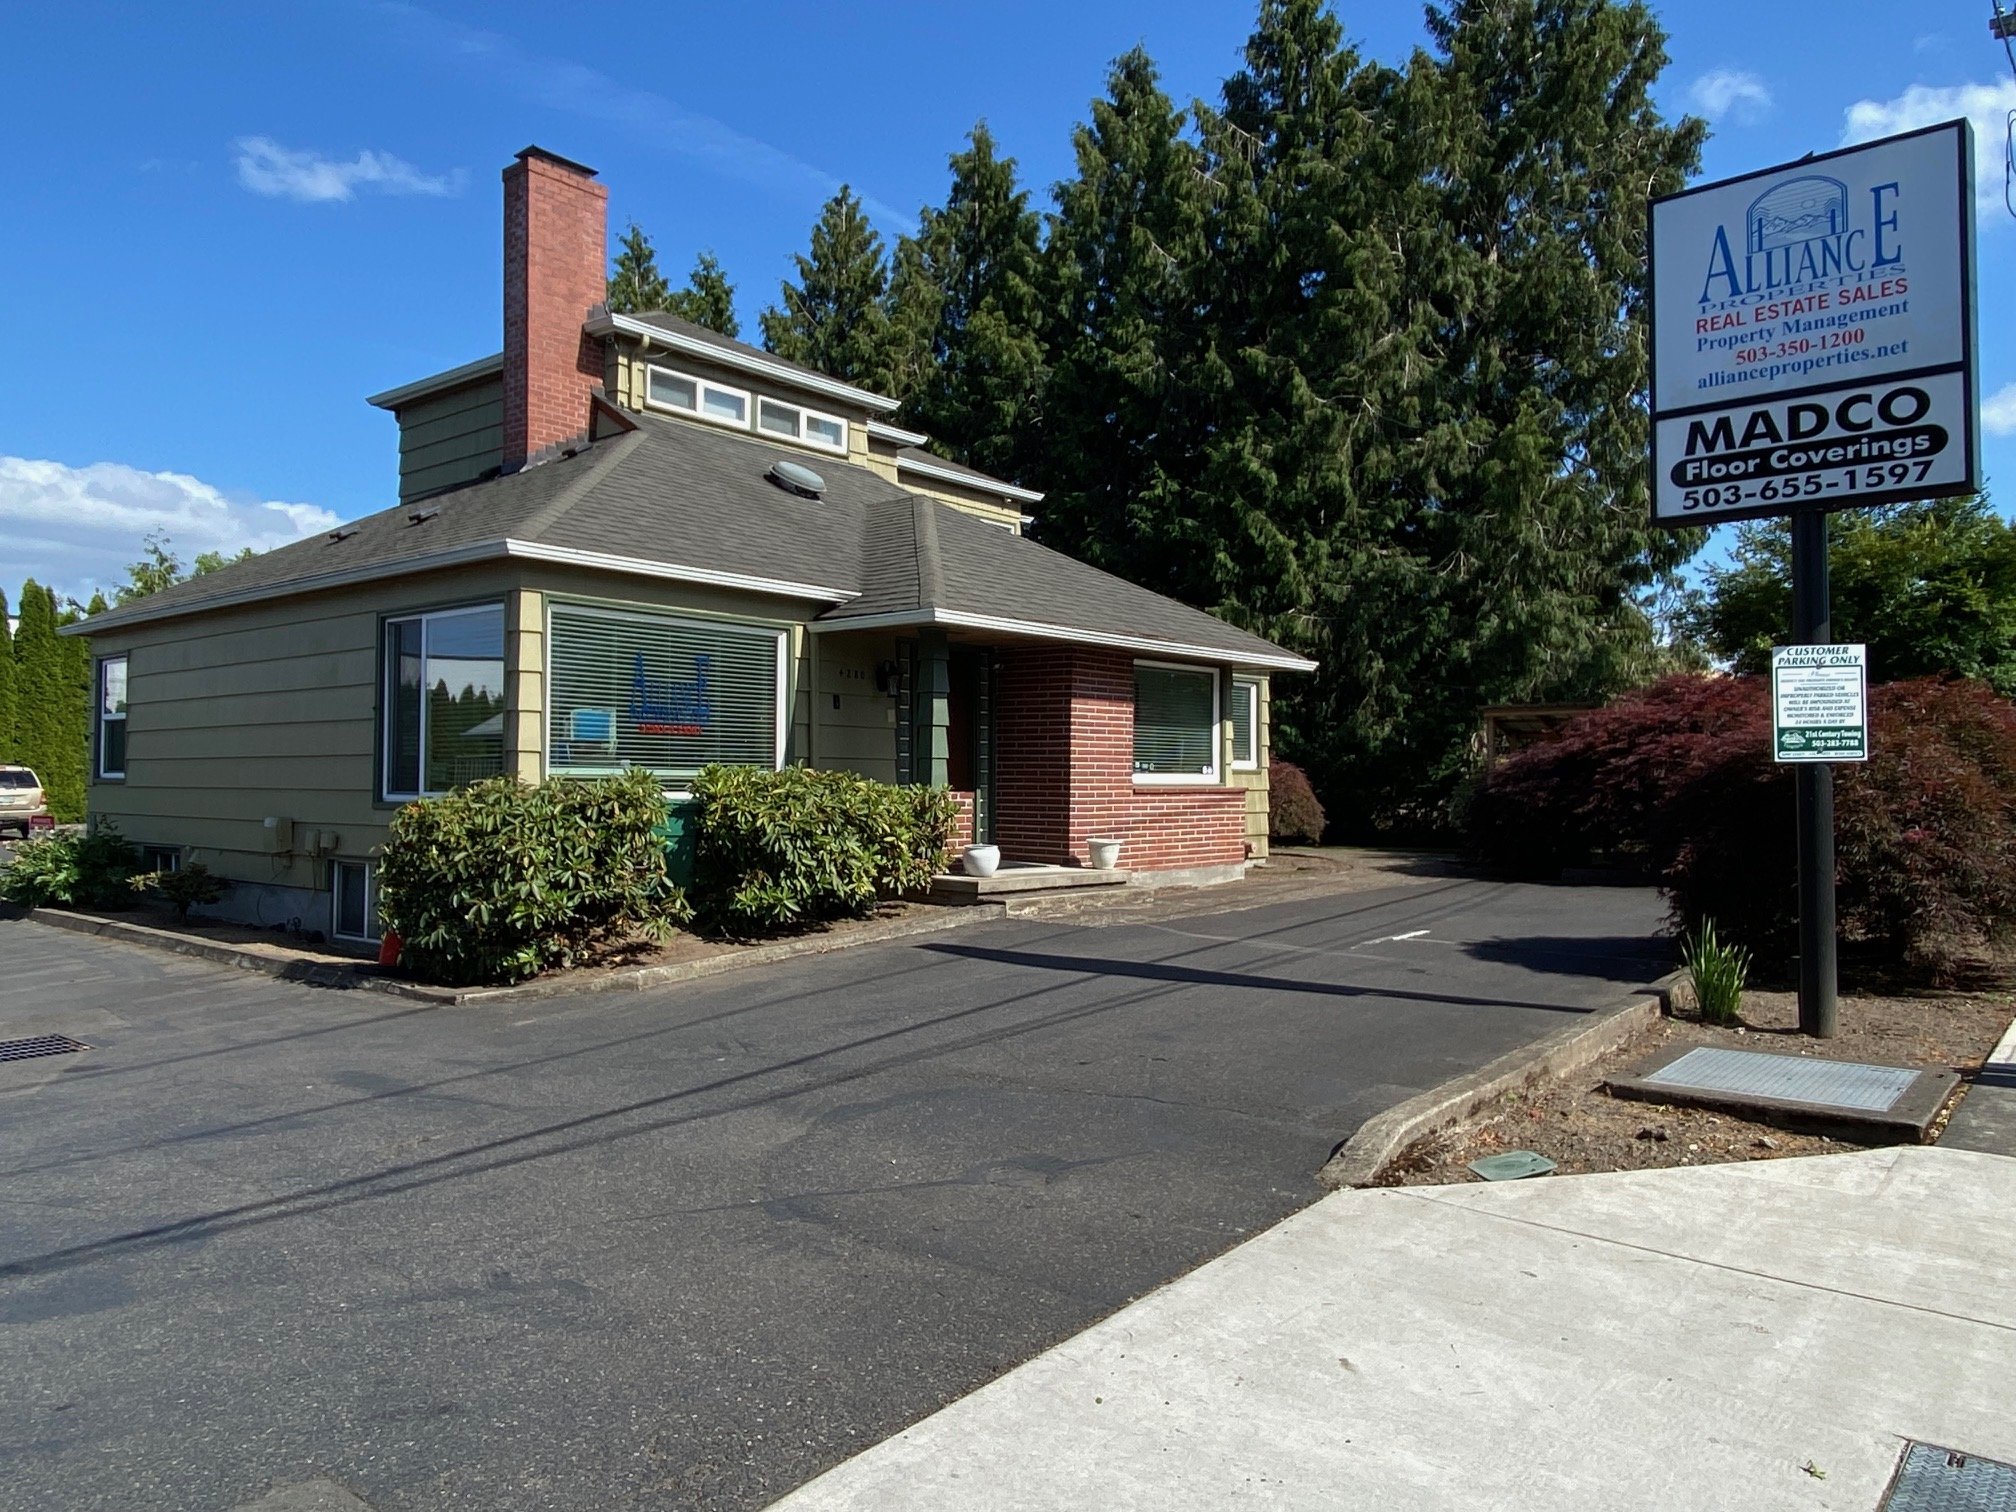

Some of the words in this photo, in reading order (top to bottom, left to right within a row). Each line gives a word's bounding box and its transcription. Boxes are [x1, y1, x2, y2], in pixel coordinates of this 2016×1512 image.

[1696, 311, 1746, 334] REAL
[1755, 293, 1830, 323] ESTATE
[1838, 278, 1908, 306] SALES
[1700, 264, 1906, 315] PROPERTIES
[1697, 326, 1776, 352] Property
[1782, 299, 1909, 336] Management
[1736, 328, 1865, 365] 503-350-1200
[1698, 339, 1909, 389] allianceproperties.net
[1684, 386, 1931, 456] MADCO
[1685, 457, 1760, 482] Floor
[1770, 434, 1931, 469] Coverings
[1682, 459, 1935, 511] 503-655-1597
[1778, 656, 1826, 666] PARKING
[1830, 656, 1860, 665] ONLY
[1786, 646, 1849, 656] CUSTOMER
[1805, 730, 1818, 738] 21st
[1818, 730, 1841, 739] Century
[1841, 729, 1862, 739] Towing
